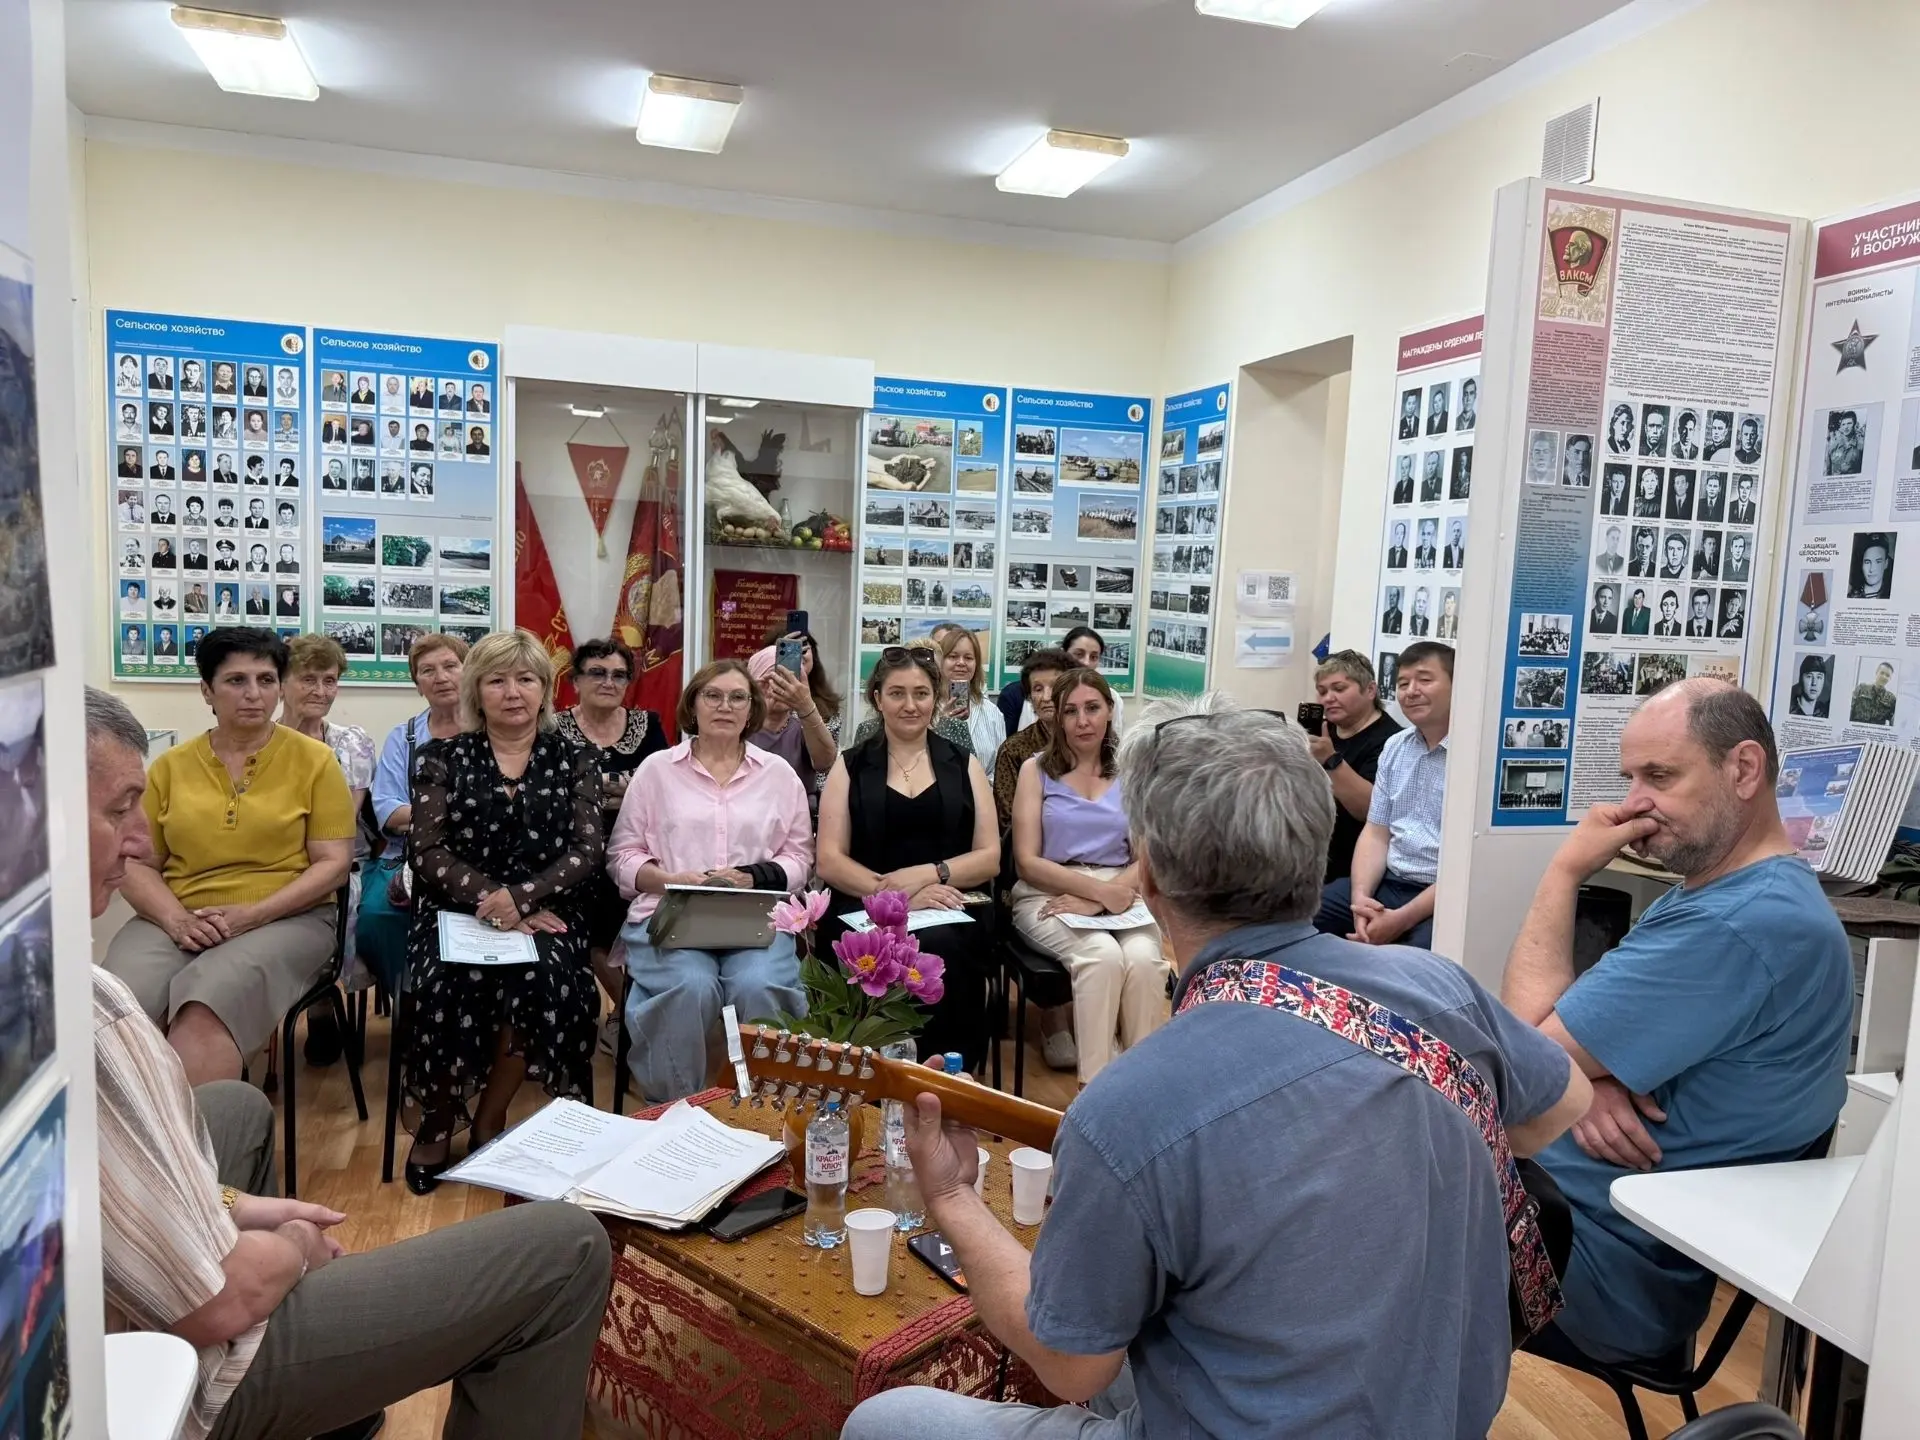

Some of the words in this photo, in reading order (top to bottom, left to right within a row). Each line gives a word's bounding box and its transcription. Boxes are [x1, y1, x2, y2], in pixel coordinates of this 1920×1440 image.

[1850, 246, 1860, 259] И
[1559, 269, 1594, 285] ВЛКСМ
[1825, 288, 1894, 308] ИНТЕРНАЦИОНАЛИСТЫ
[115, 318, 168, 332] Сельское
[171, 323, 226, 337] хозяйство
[320, 336, 369, 349] Сельское
[371, 341, 422, 354] хозяйство
[1402, 341, 1443, 358] НАГРАЖДЕНЫ
[1443, 333, 1474, 348] ОРДЕНОМ
[1474, 330, 1484, 340] ЛЕ
[873, 385, 904, 394] ельское
[906, 387, 947, 398] хозяйство
[1017, 394, 1054, 406] Сельское
[1055, 399, 1094, 409] хозяйство
[1260, 963, 1280, 1005] ROCK
[822, 1161, 842, 1170] КЛЮЧ
